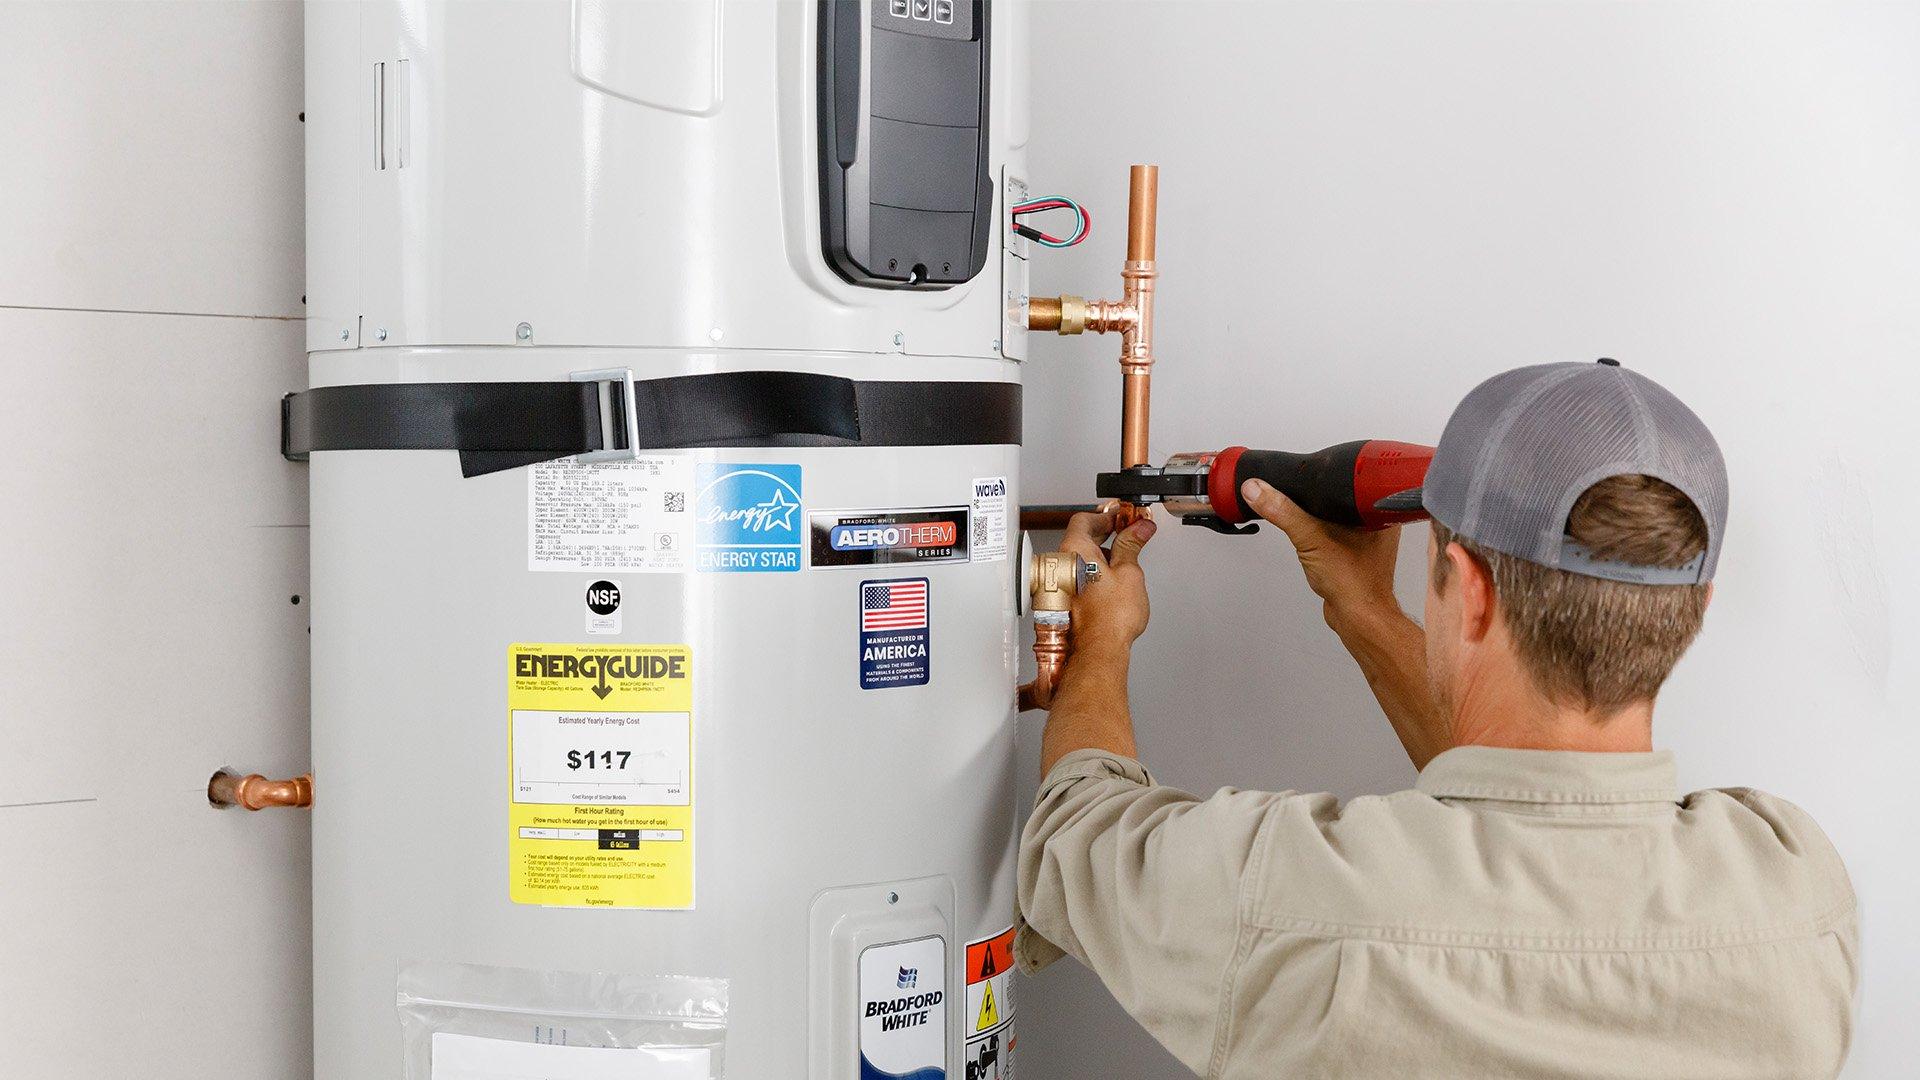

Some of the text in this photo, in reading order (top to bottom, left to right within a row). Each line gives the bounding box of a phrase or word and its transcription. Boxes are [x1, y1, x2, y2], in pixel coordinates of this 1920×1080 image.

[975, 484, 999, 497] wave
[698, 505, 778, 532] energy
[837, 526, 953, 547] AEROTHERM
[701, 551, 758, 567] ENERGY
[760, 551, 796, 567] STAR
[918, 548, 951, 557] SERIES
[589, 589, 619, 606] NSF
[866, 635, 917, 645] MANUFACTURED
[863, 643, 927, 661] AMERICA
[516, 654, 686, 679] ENERGYGUIDE
[558, 716, 640, 727] Estimated Yearly Energy Cost
[567, 749, 632, 771] $117
[574, 807, 625, 816] First Hour Rating
[864, 990, 943, 1018] BRADFORD
[881, 1010, 929, 1033] WHITE
